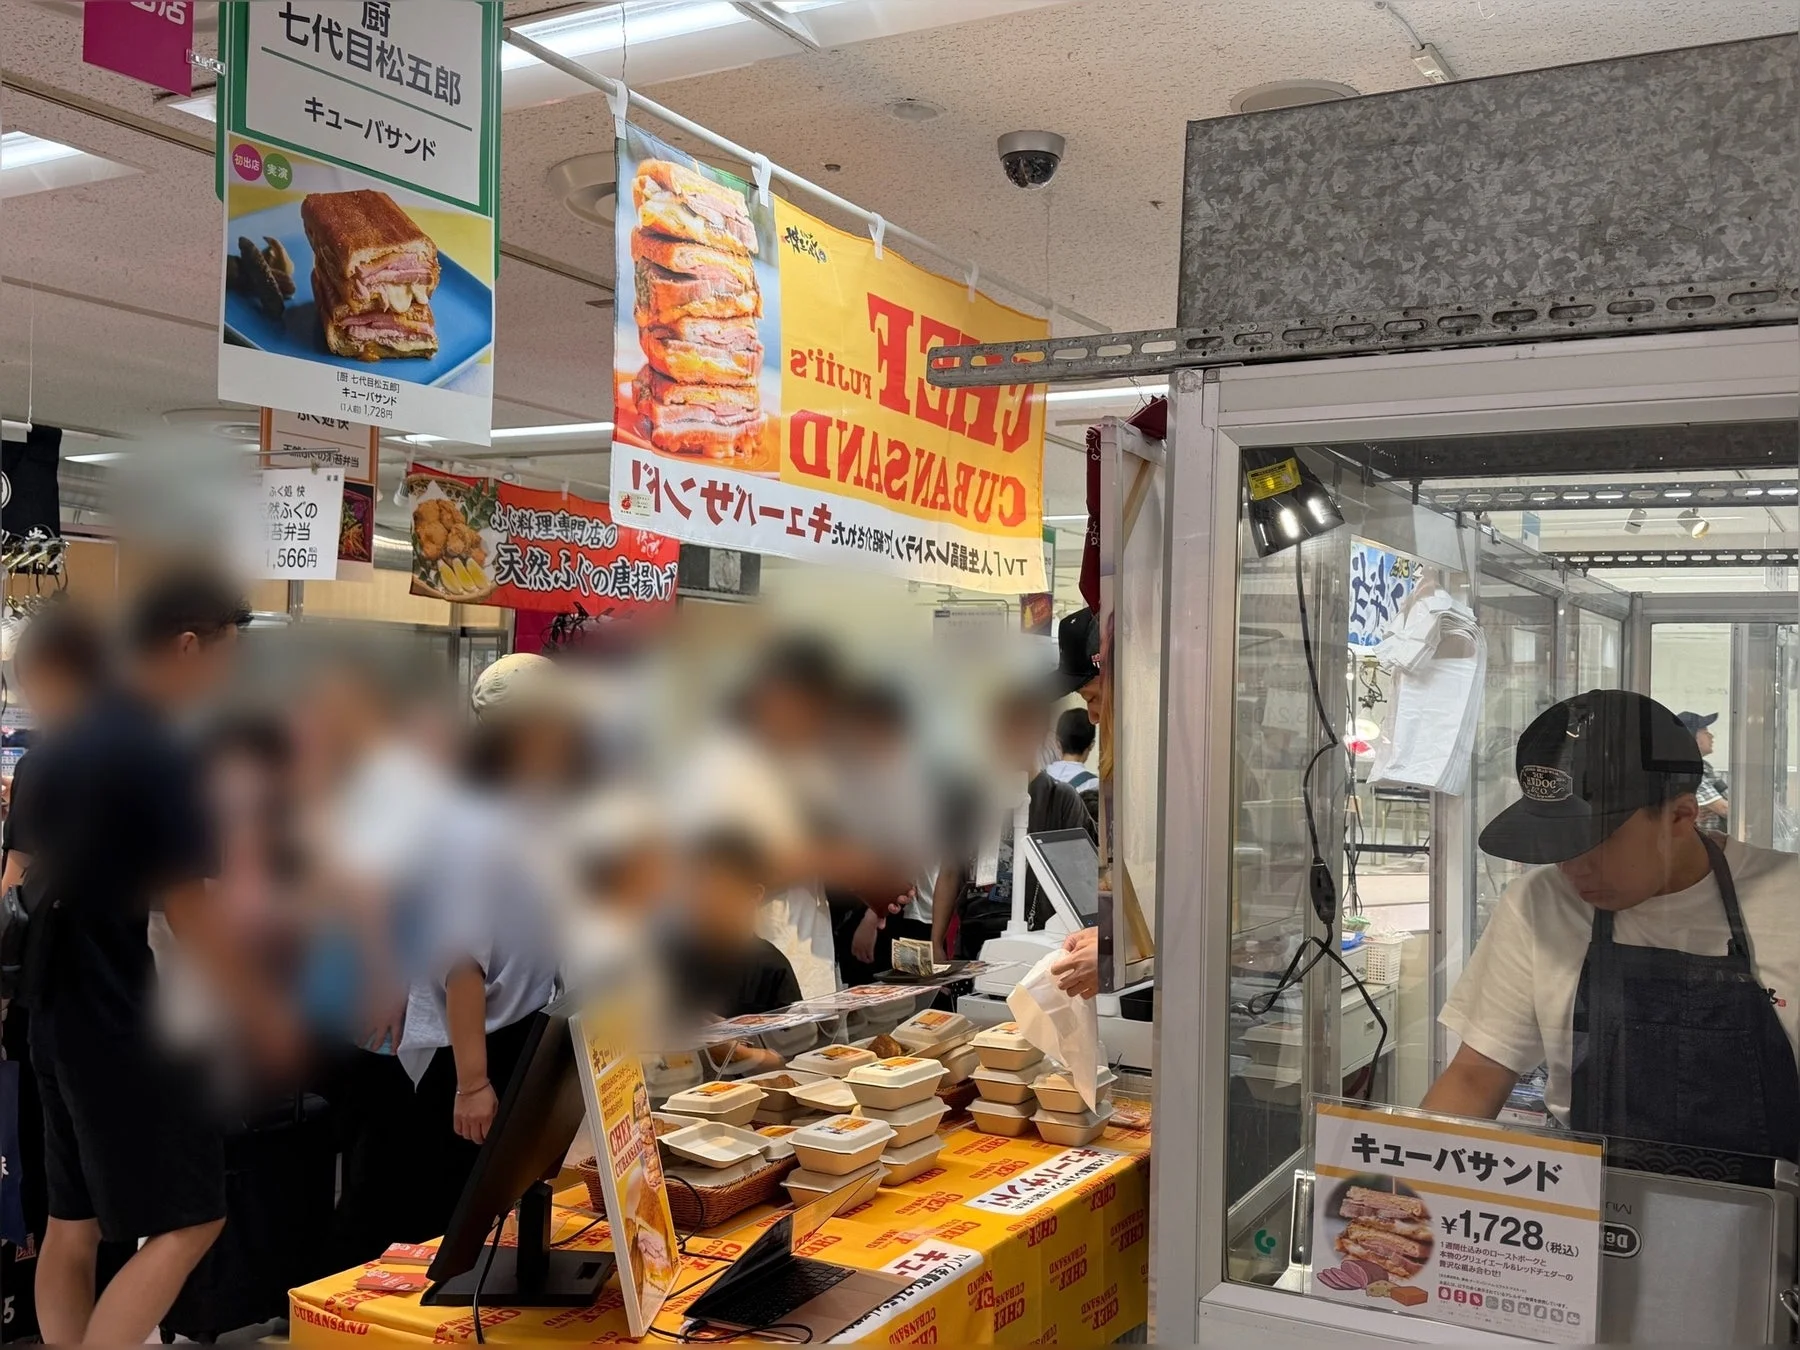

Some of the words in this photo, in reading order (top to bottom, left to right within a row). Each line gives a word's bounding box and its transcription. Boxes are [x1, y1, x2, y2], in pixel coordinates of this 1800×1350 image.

[278, 1, 462, 106] 七代目松五郎
[304, 97, 436, 160] キューバサンド
[234, 153, 260, 172] 初出店
[267, 163, 289, 180] 実演
[341, 387, 397, 406] キューバサンド
[260, 502, 318, 520] 然ふぐの
[490, 502, 618, 550] ふぐ料理専門店の
[264, 522, 311, 542] 苔弁当
[497, 544, 679, 602] 天然ふぐの唐揚げ
[609, 1114, 633, 1157] CHEF
[977, 1149, 1101, 1208] キューバサンド!
[993, 1160, 1031, 1179] CHEF
[1351, 1132, 1563, 1192] キューバサンド
[928, 1193, 964, 1214] CHEF
[1090, 1182, 1116, 1212] CHEF
[935, 1220, 983, 1241] CHEF
[1027, 1215, 1058, 1249] CHEF
[1441, 1209, 1544, 1250] ¥1,728
[1545, 1240, 1580, 1258] (税込)
[1049, 1243, 1088, 1275] CUBANSAND
[1440, 1240, 1548, 1268] 1週間仕込みのローストポークと
[1058, 1258, 1088, 1292] CHEF
[1081, 1282, 1118, 1316] CUBANSAND
[1091, 1297, 1119, 1331] CHEF
[293, 1304, 370, 1337] CUBANSAND
